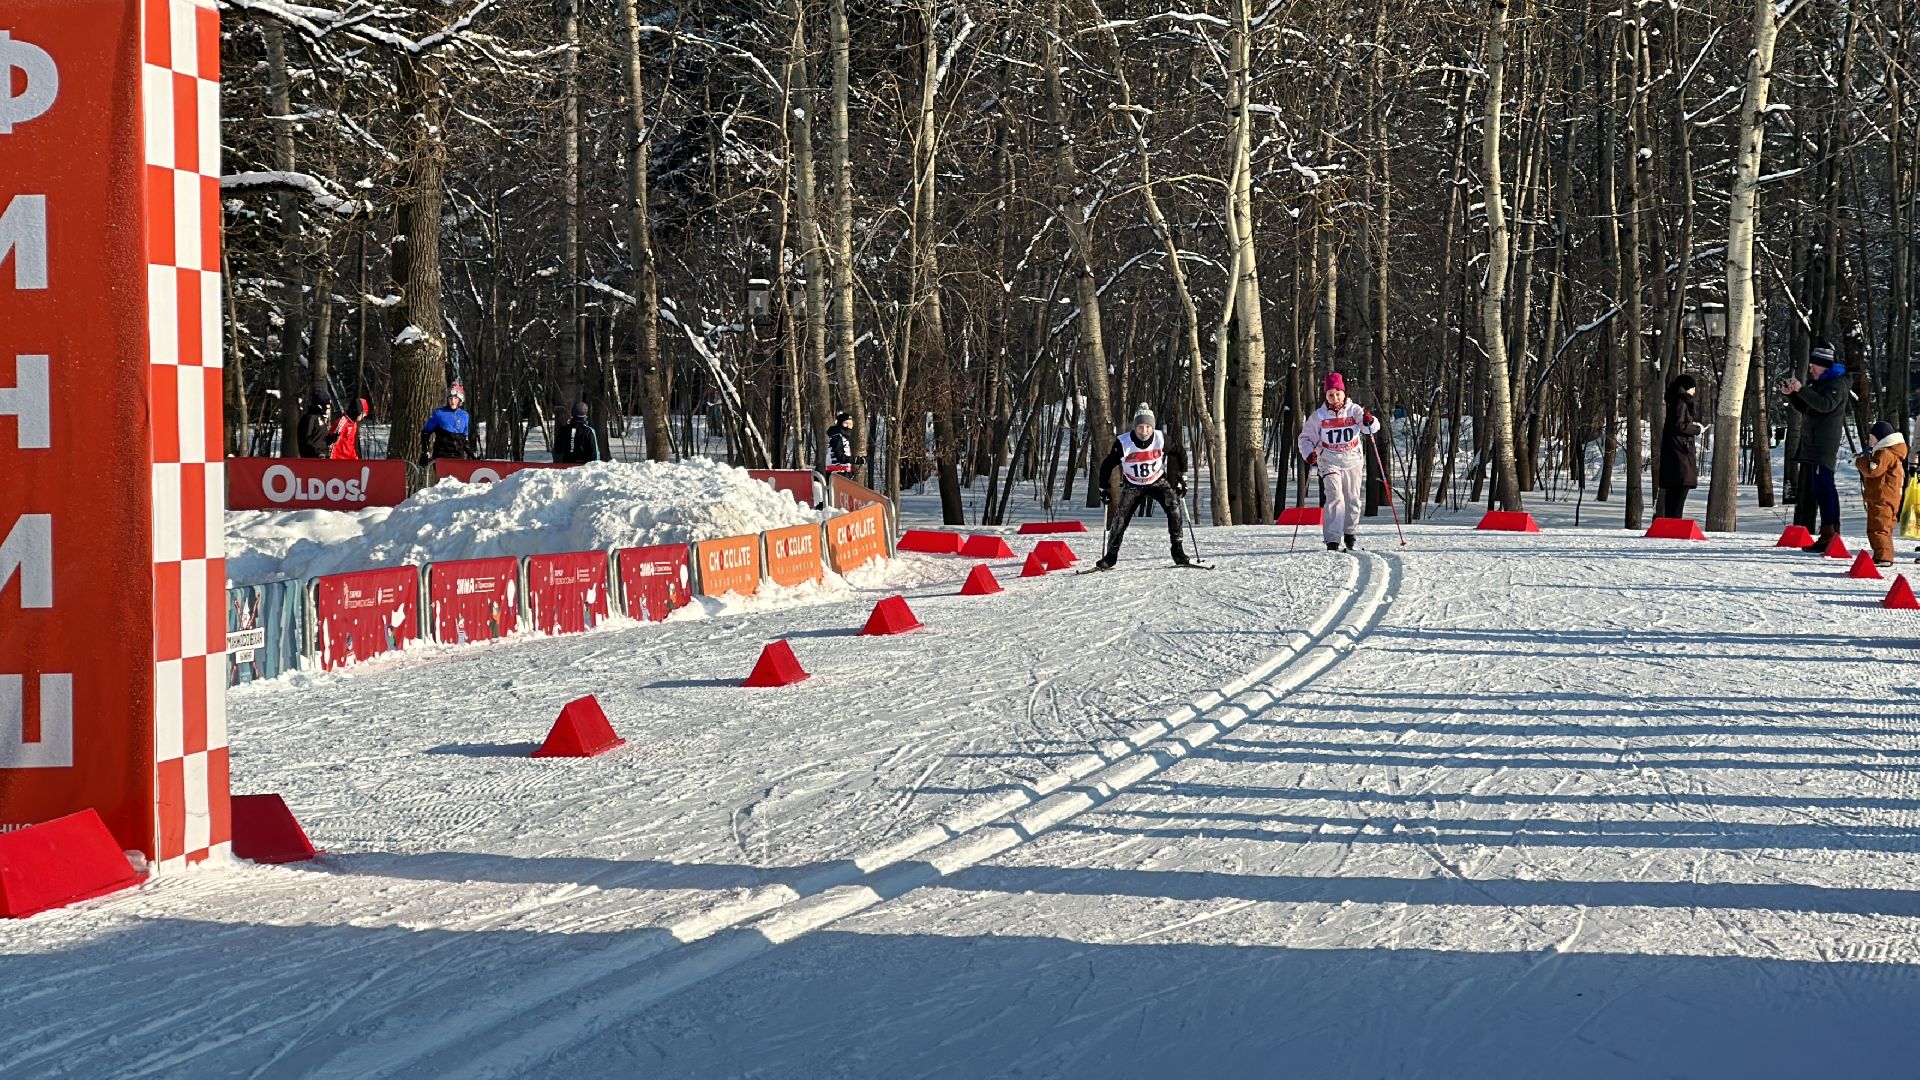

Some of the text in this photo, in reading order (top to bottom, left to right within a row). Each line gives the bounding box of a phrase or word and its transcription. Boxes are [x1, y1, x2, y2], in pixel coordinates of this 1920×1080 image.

[1326, 428, 1354, 444] 170
[837, 517, 876, 545] CHOCOLATE
[709, 546, 751, 572] CHOCOLATE
[775, 535, 813, 559] CHOCOLATE
